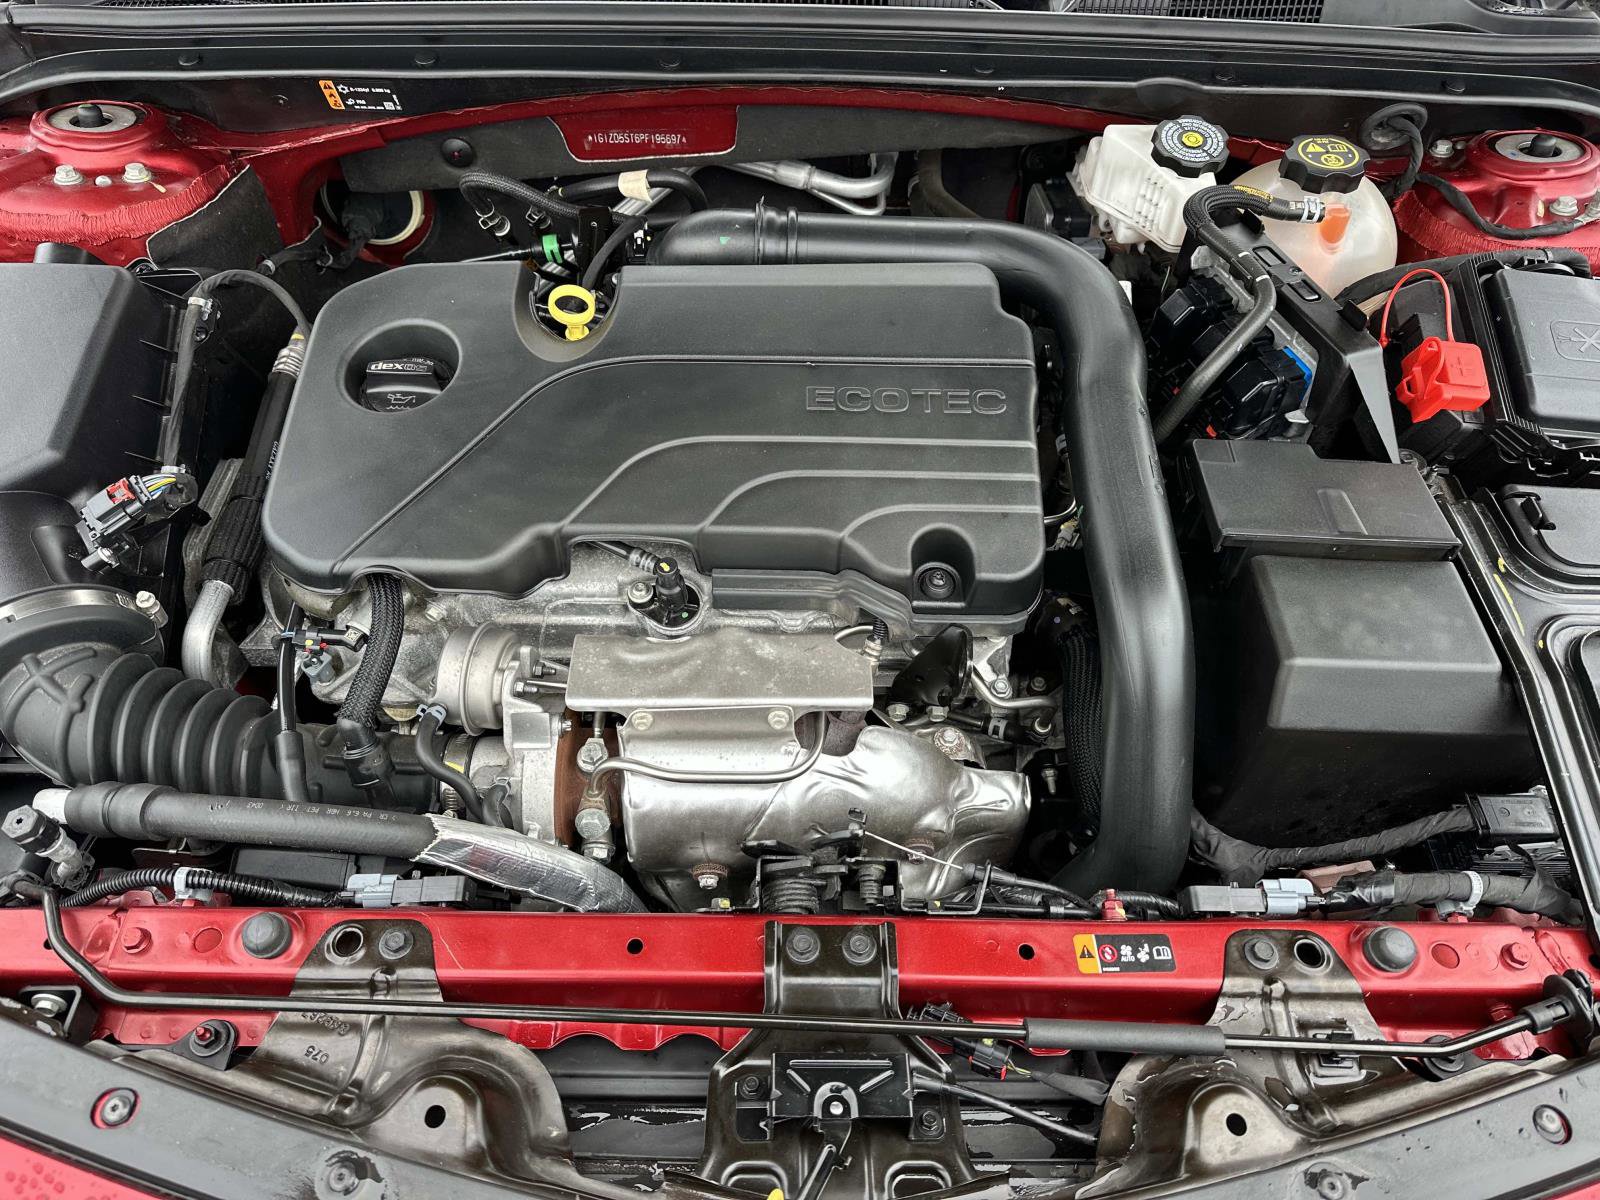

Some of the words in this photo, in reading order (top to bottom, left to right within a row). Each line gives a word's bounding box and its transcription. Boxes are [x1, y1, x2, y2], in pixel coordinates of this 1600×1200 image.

[371, 361, 428, 371] dexos
[806, 386, 1007, 415] ECOTEC
[304, 1045, 330, 1064] 075
